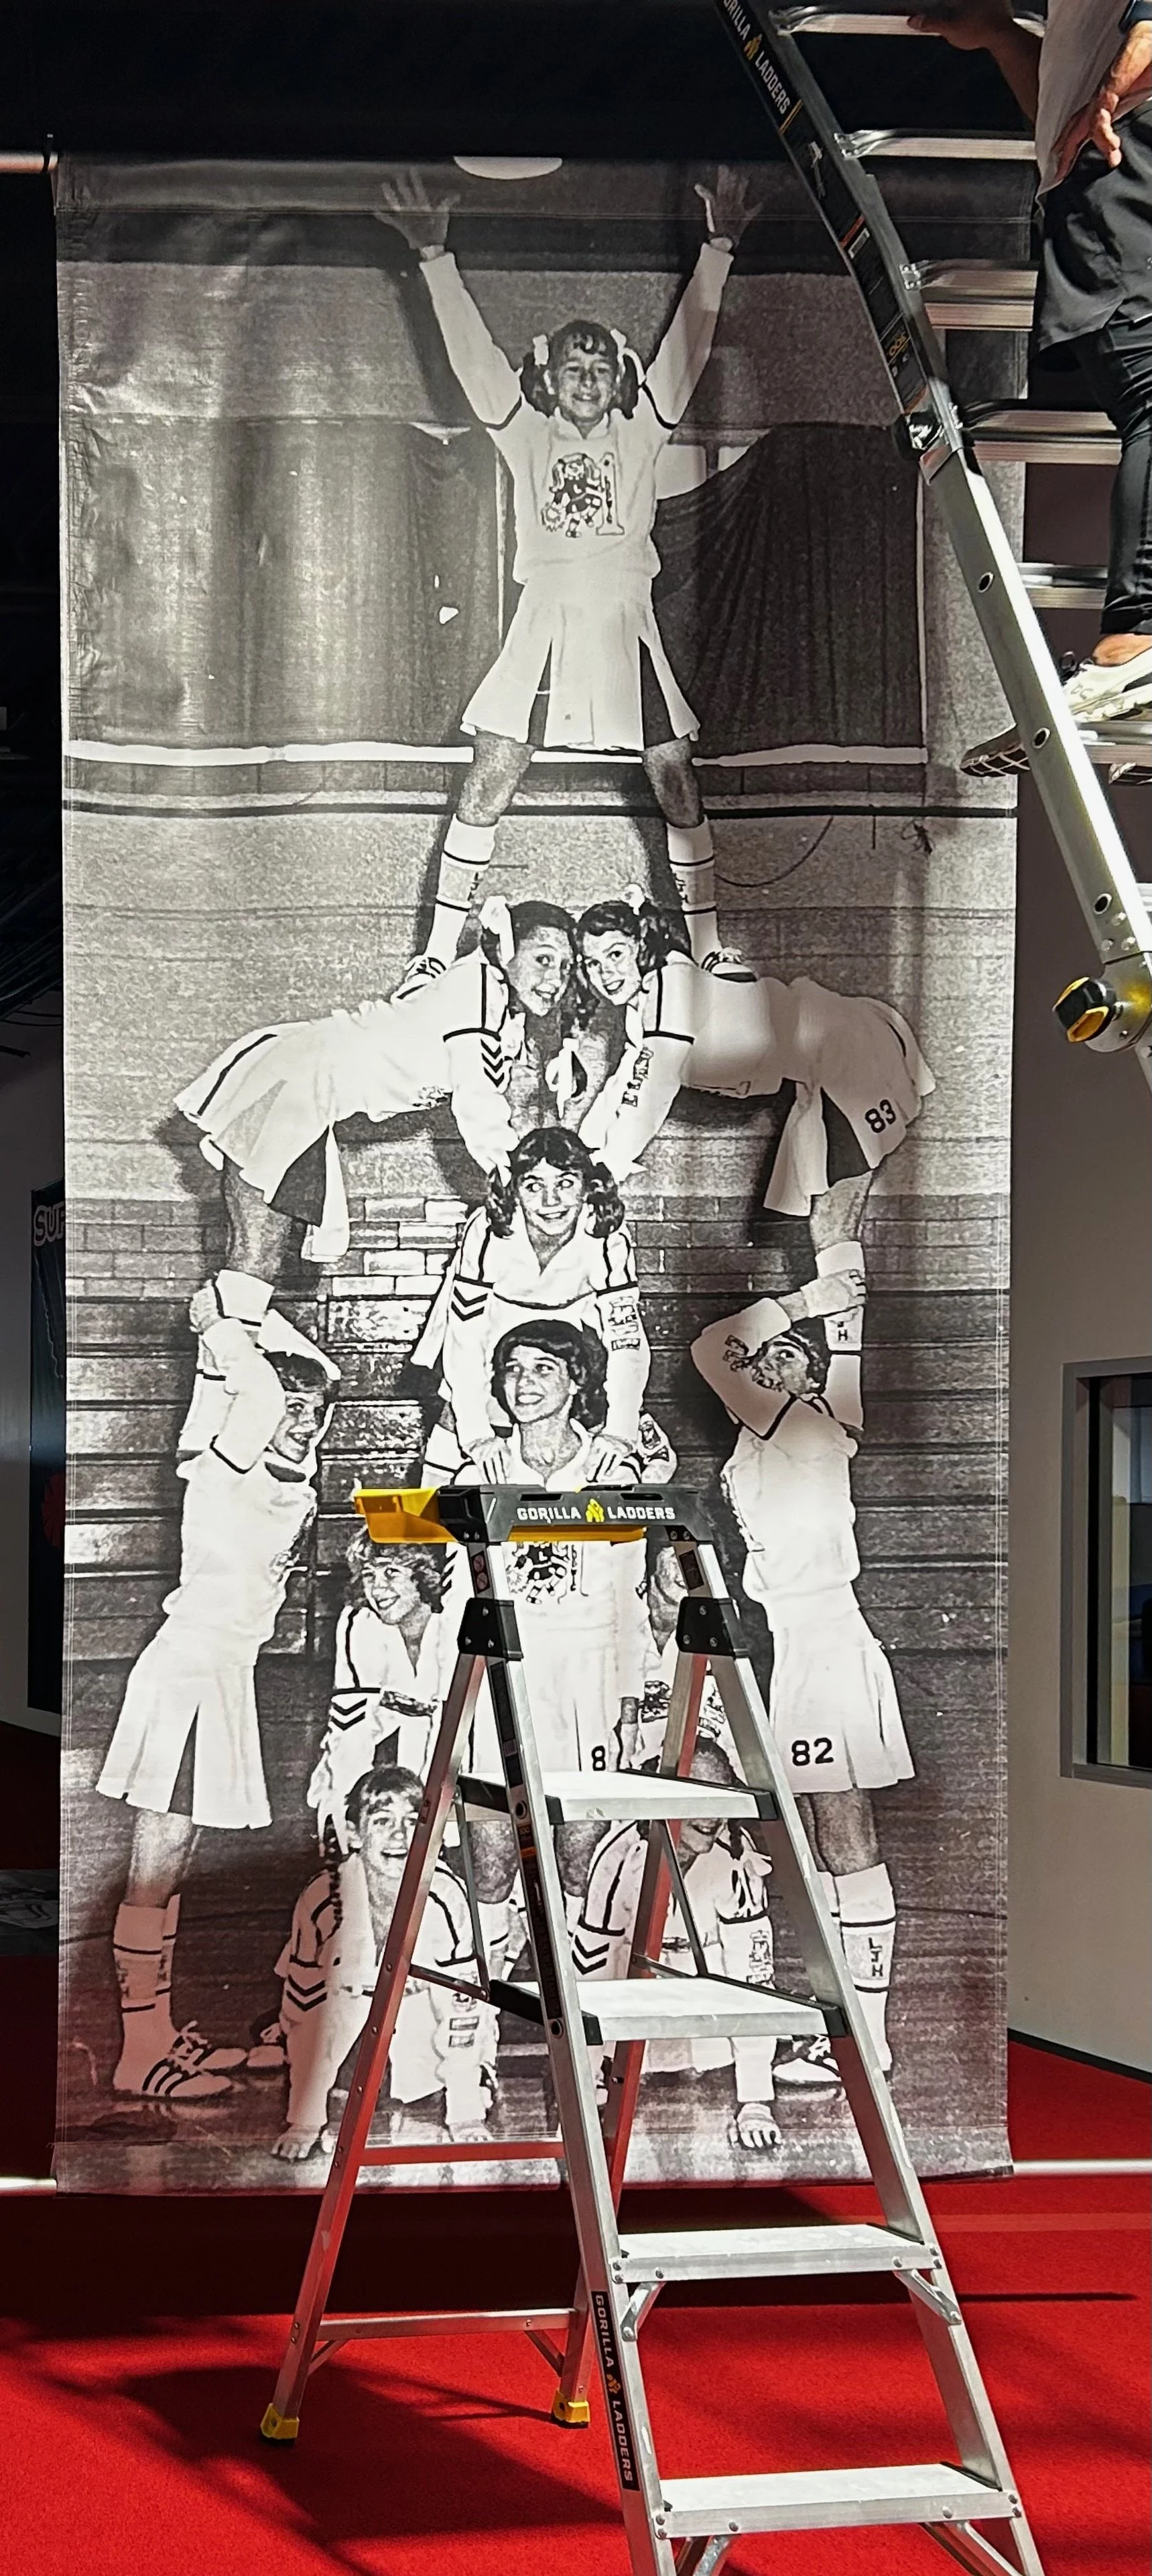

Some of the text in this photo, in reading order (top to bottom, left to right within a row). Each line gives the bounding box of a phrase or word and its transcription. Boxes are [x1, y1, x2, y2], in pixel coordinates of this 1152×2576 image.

[723, 0, 791, 115] RILLA LADDERS
[865, 1099, 897, 1133] 83
[517, 1506, 676, 1523] GORILLA LADDERS
[791, 1737, 834, 1766] 82
[595, 2294, 633, 2482] GORILLA LADDERS
